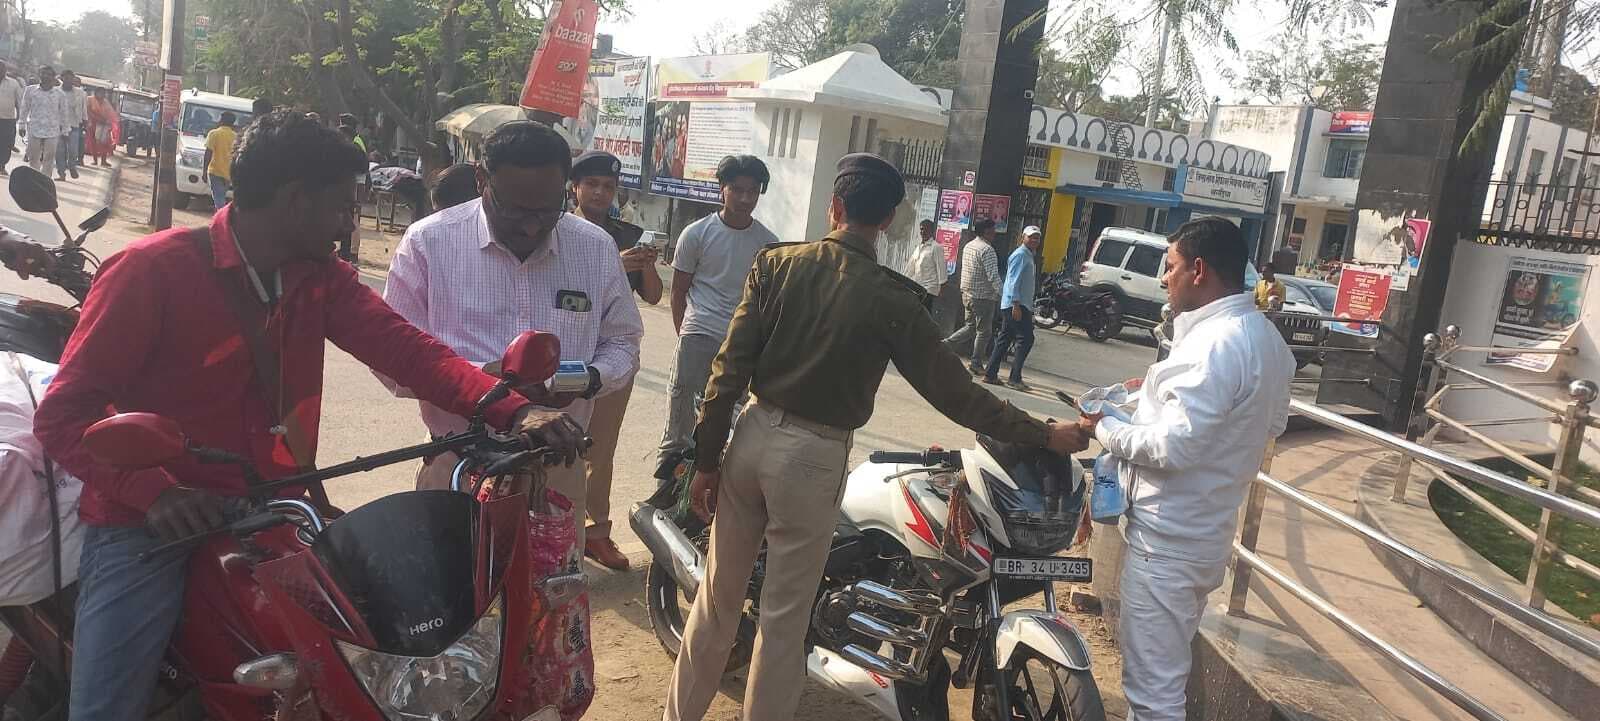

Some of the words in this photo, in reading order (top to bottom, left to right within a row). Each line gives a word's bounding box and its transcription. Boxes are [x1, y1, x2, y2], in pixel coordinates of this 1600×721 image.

[1008, 560, 1022, 572] BR
[1031, 561, 1045, 573] 34
[409, 618, 443, 635] Hero
